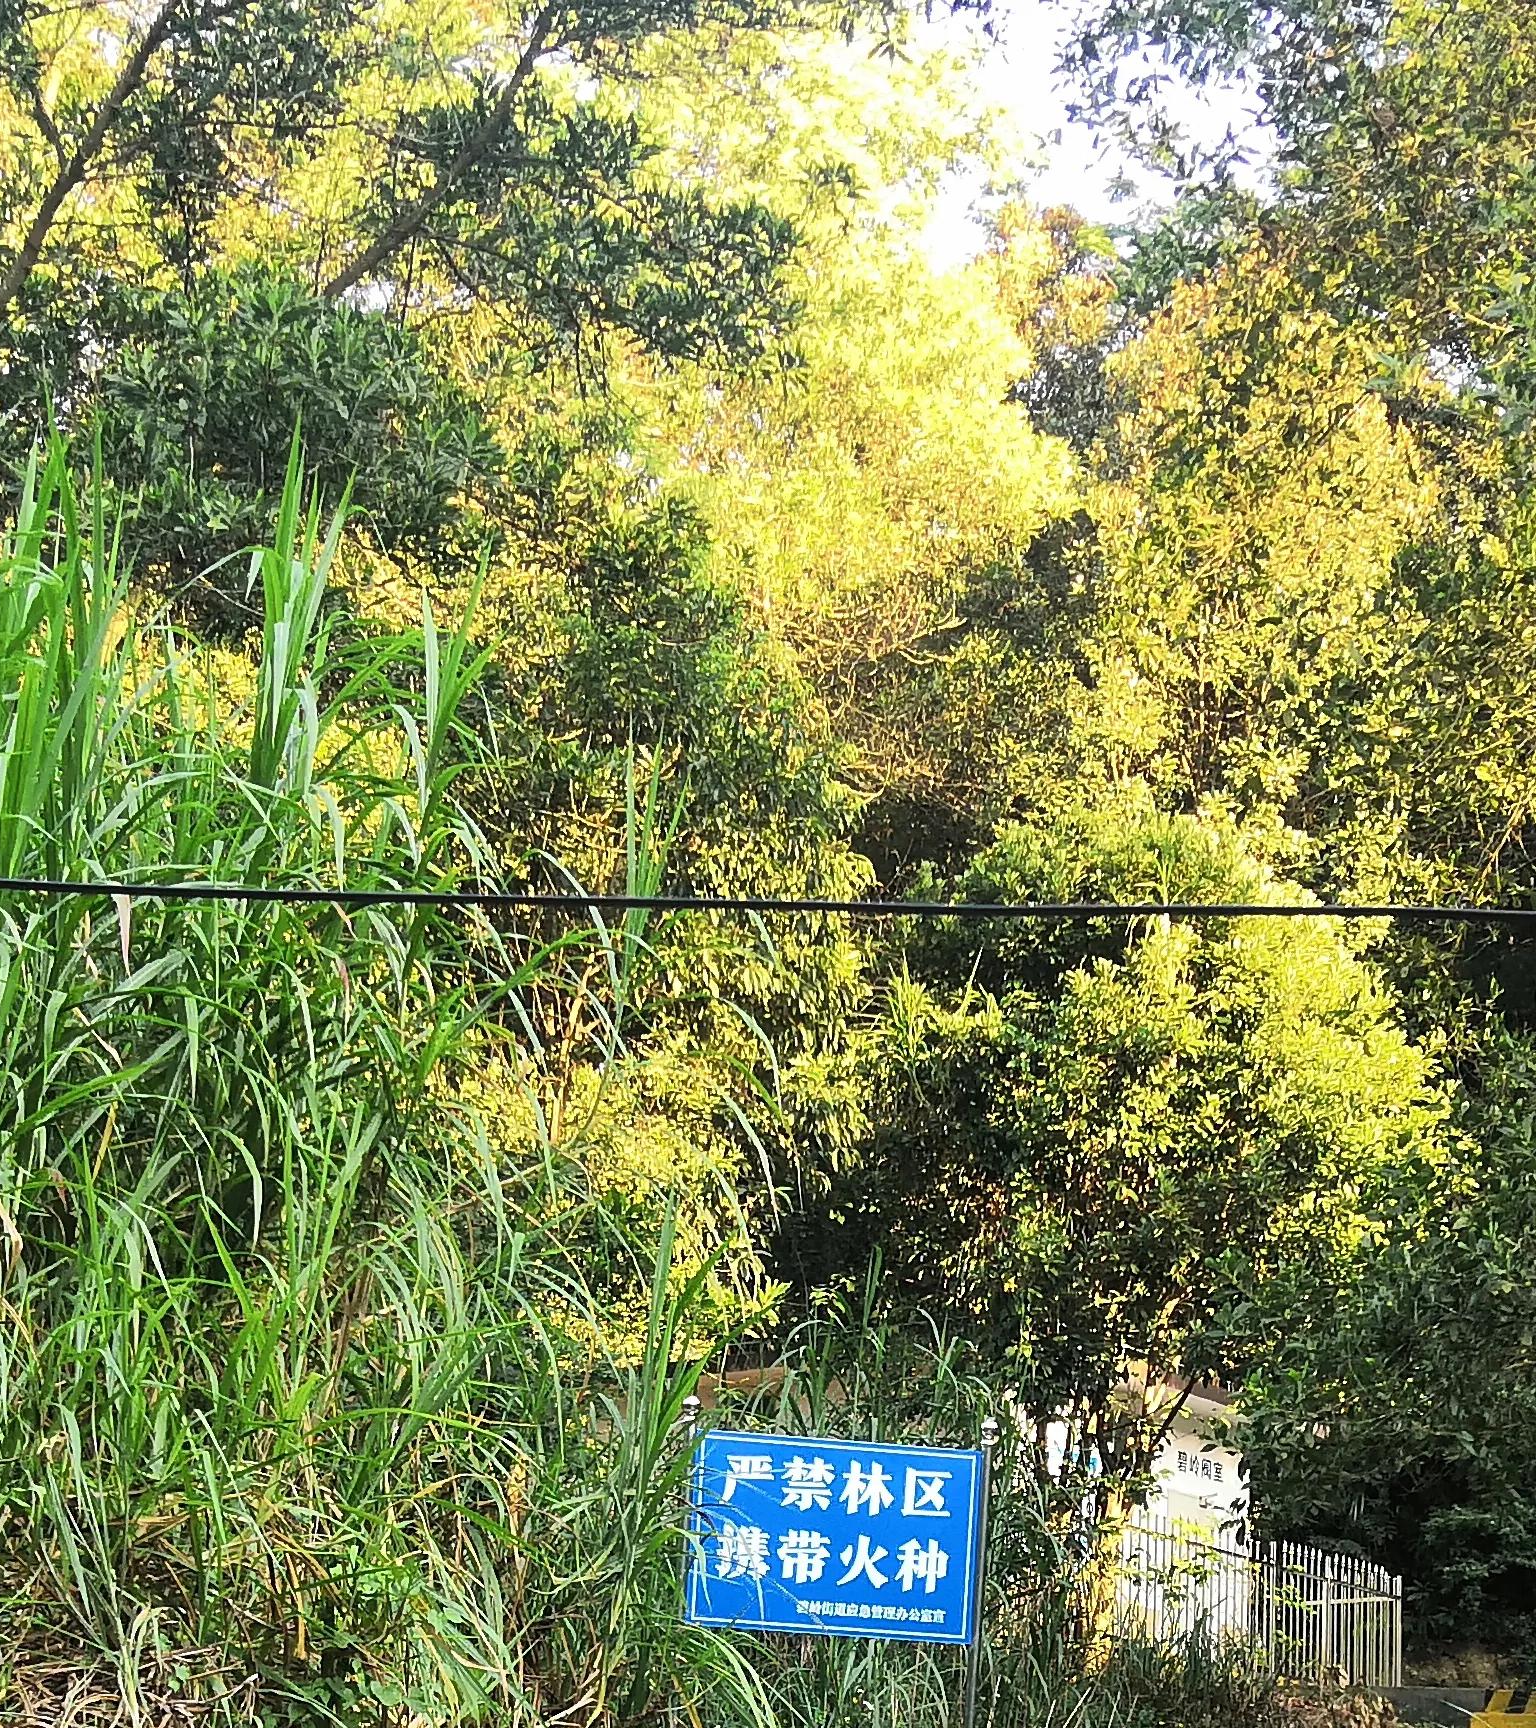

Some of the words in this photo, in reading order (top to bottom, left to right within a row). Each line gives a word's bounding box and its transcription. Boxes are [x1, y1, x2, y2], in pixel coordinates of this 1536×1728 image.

[721, 1454, 953, 1517] 严禁林区
[715, 1524, 949, 1595] 携带火种
